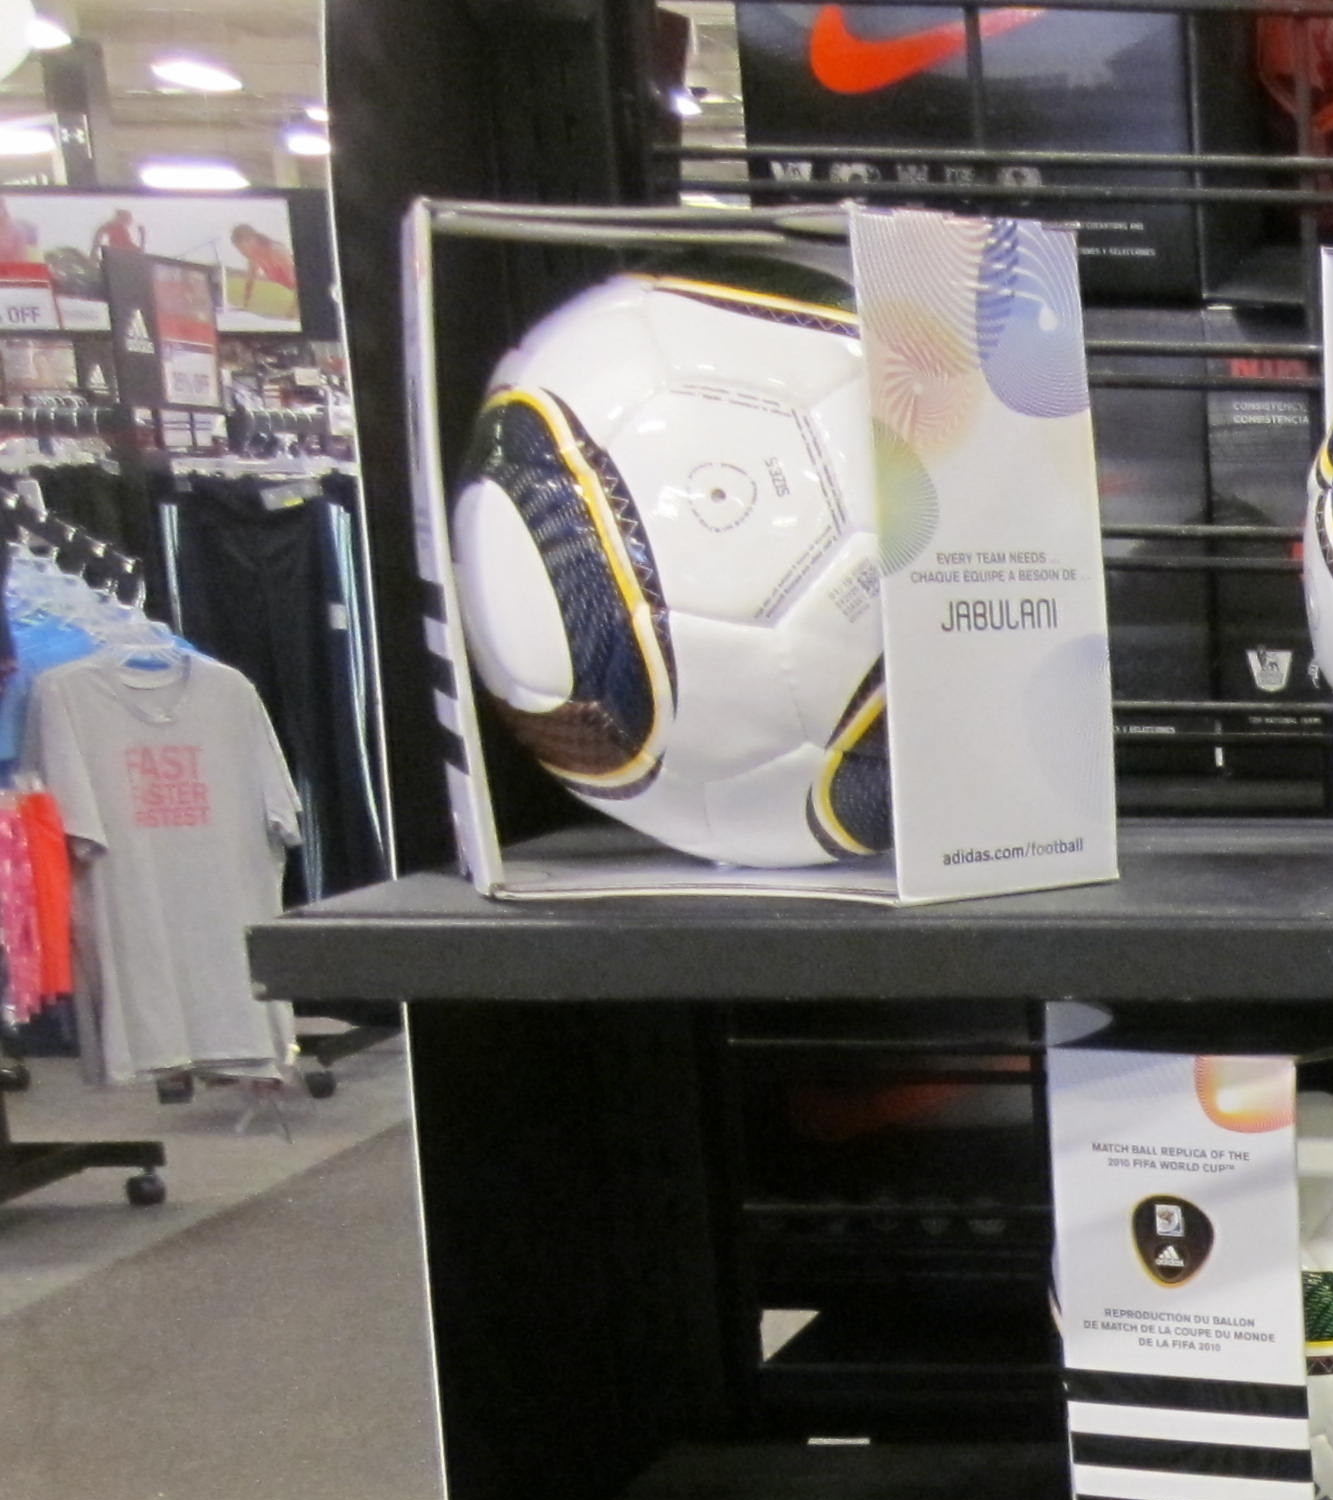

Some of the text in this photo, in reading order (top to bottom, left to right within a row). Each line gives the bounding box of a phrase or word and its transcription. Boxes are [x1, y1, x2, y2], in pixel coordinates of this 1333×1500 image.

[935, 550, 1047, 565] EVERY TEAM NEEDS
[909, 569, 960, 584] CHAQUE
[1017, 568, 1060, 582] BESOIN
[1061, 567, 1077, 581] DE
[940, 597, 1058, 632] JABULANI
[942, 837, 1085, 867] adidas.com/football
[1091, 1142, 1250, 1161] MATCH BALL REPLICA OF THE
[1132, 1157, 1157, 1169] FIFA
[1158, 1159, 1200, 1172] WORLD
[1103, 1307, 1255, 1328] REPRODUCTION DU BALLON
